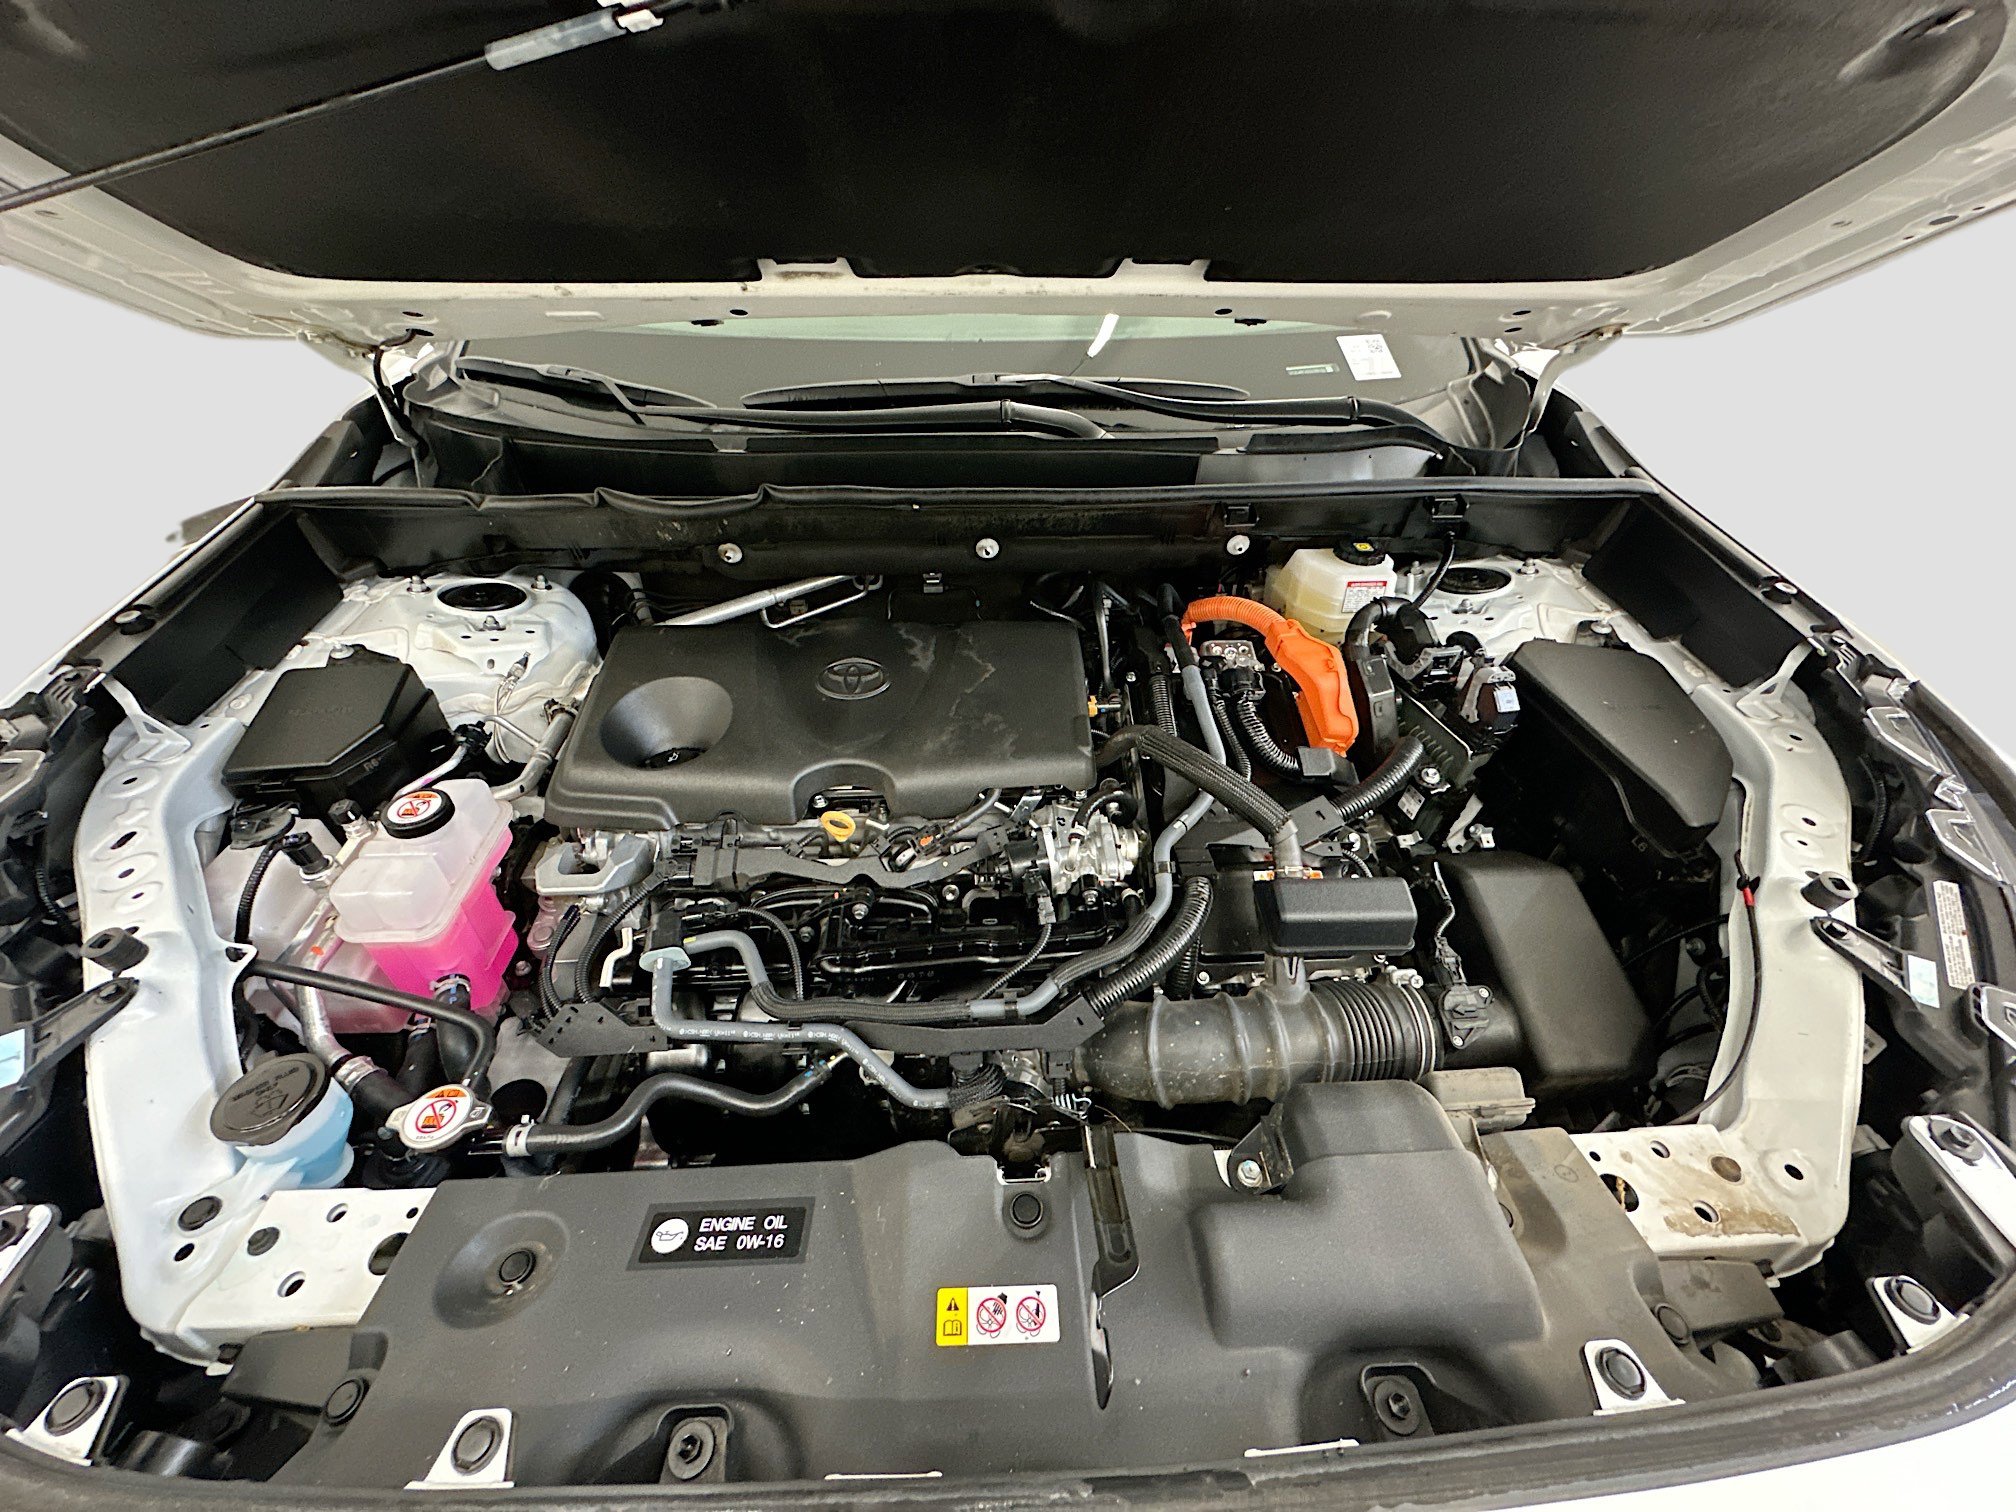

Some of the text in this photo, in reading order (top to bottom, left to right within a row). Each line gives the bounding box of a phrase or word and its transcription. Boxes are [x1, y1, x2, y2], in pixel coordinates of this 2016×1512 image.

[699, 1214, 788, 1233] ENGINE OIL
[693, 1233, 785, 1252] SAE 0W-16
